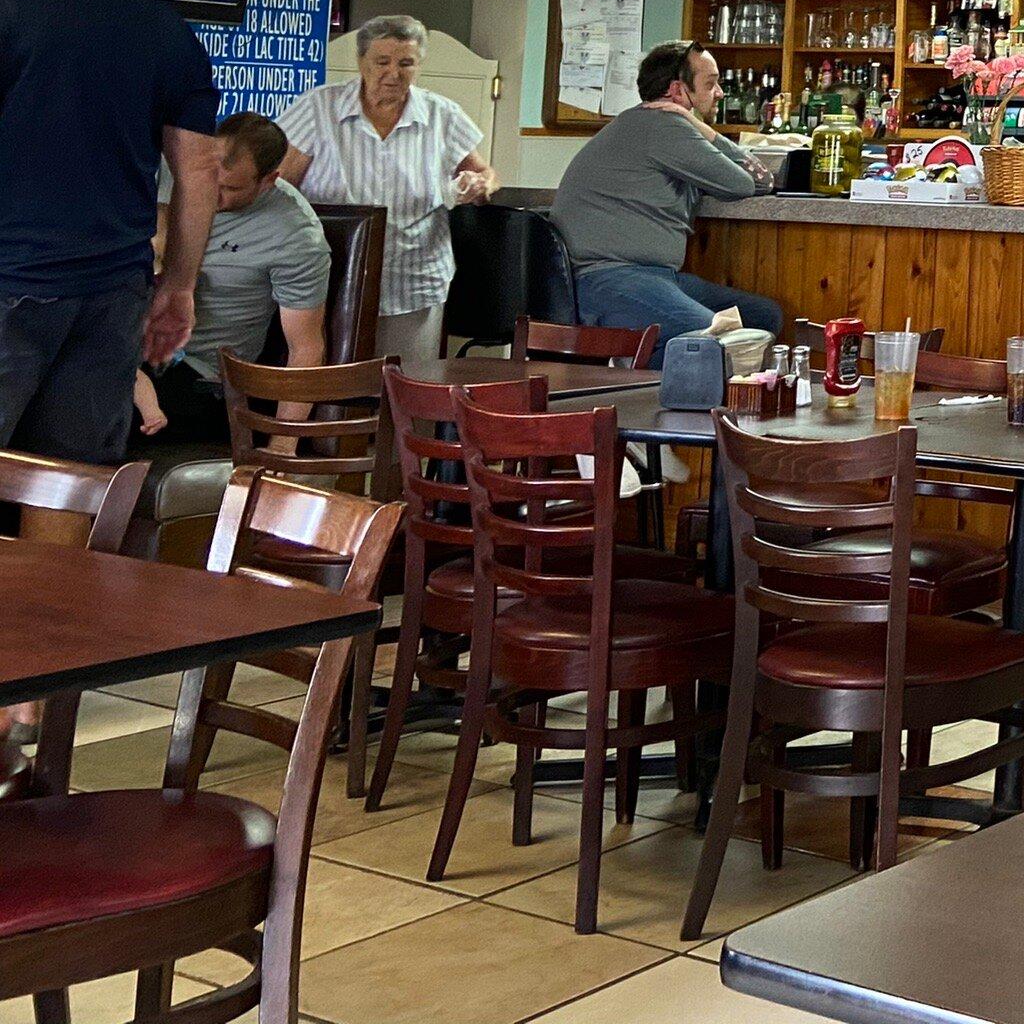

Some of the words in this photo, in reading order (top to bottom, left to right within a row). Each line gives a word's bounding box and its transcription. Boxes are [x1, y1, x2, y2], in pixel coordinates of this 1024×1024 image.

[246, 10, 258, 32] 18
[261, 11, 312, 36] ALLOWED
[232, 34, 252, 59] (BY
[255, 36, 275, 60] LAC
[277, 37, 304, 61] TITLE
[307, 40, 324, 62] 42)
[212, 65, 254, 91] PERSON
[258, 66, 295, 92] UNDER
[298, 69, 318, 89] THE
[233, 93, 243, 115] 21
